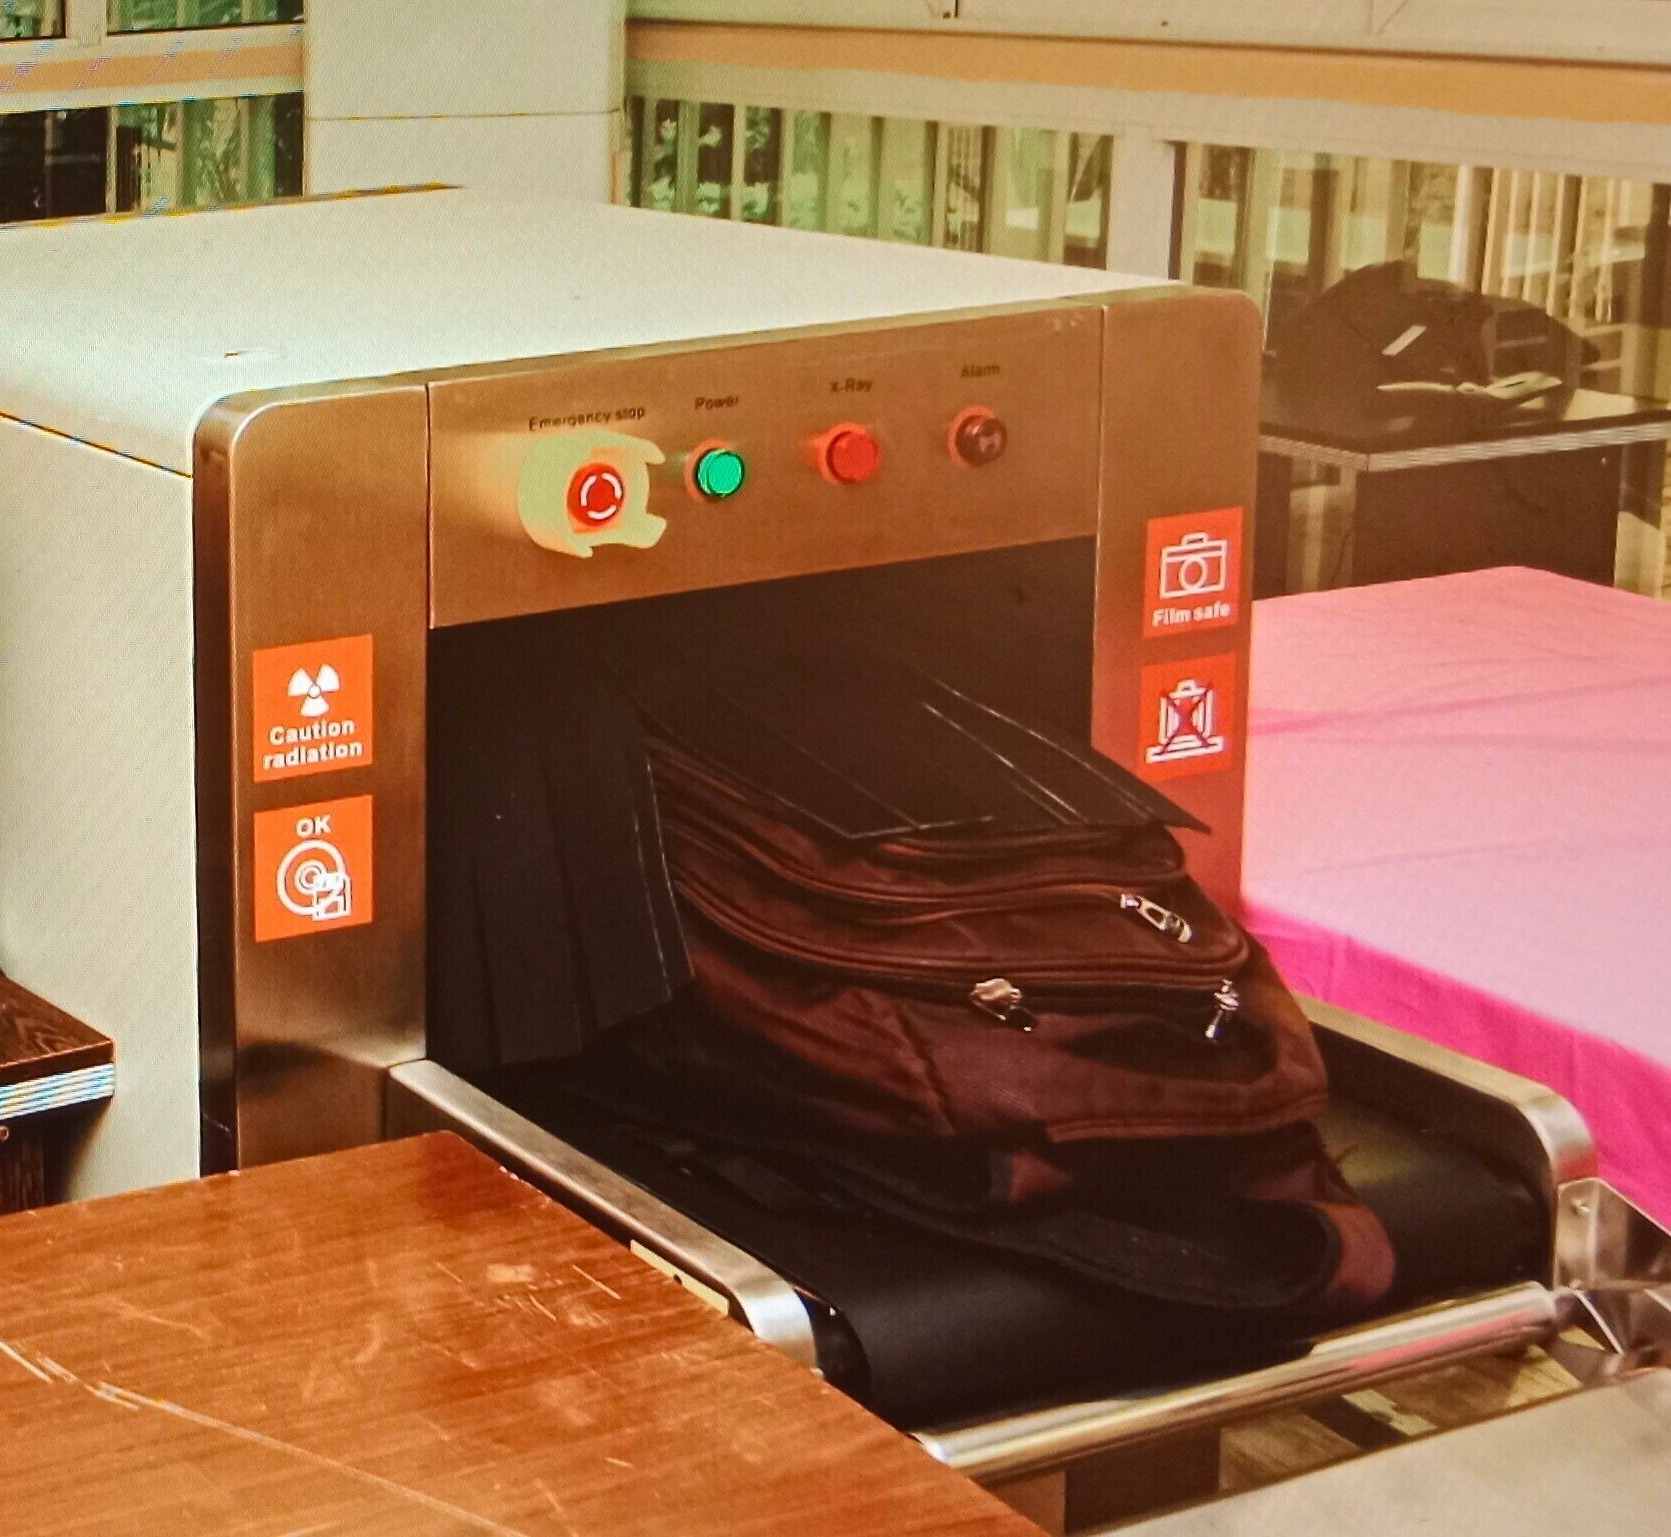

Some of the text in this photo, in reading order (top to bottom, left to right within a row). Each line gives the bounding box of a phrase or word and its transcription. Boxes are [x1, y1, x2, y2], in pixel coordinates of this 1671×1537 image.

[960, 364, 1001, 379] Alarm
[695, 396, 740, 410] Power
[528, 406, 646, 431] Emergency stop
[1152, 601, 1231, 627] Film safe
[269, 719, 356, 745] Caution
[262, 742, 364, 770] radiation
[296, 814, 331, 838] OK
